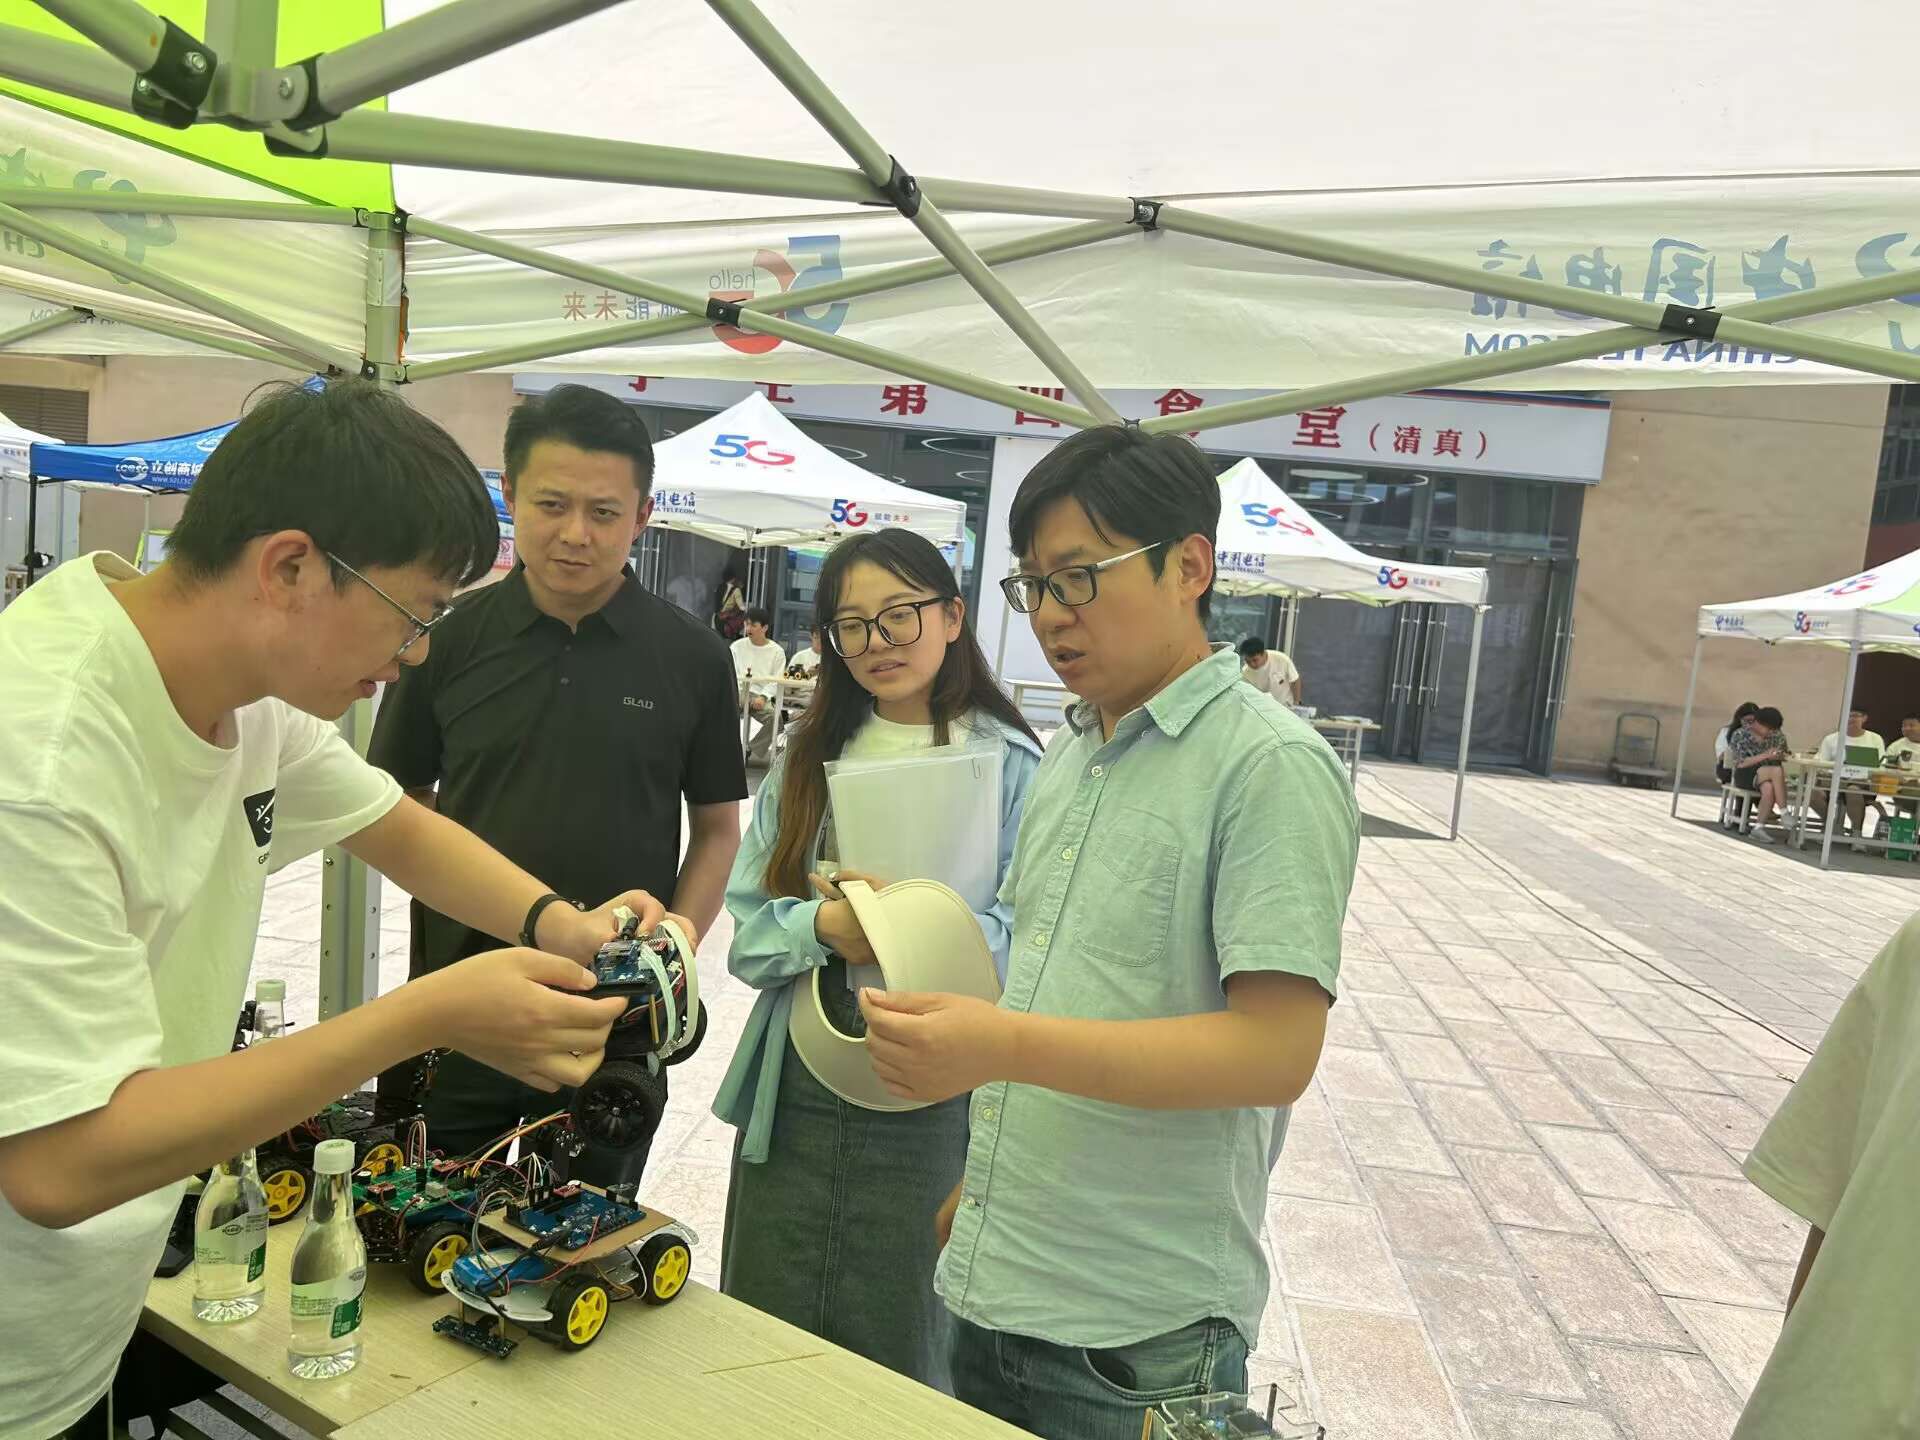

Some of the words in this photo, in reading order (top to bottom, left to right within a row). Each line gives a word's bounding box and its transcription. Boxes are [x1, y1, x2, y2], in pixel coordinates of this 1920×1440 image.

[709, 434, 796, 466] 5G
[830, 498, 869, 528] 5G
[1240, 502, 1315, 536] 5G
[1376, 565, 1409, 590] 5G
